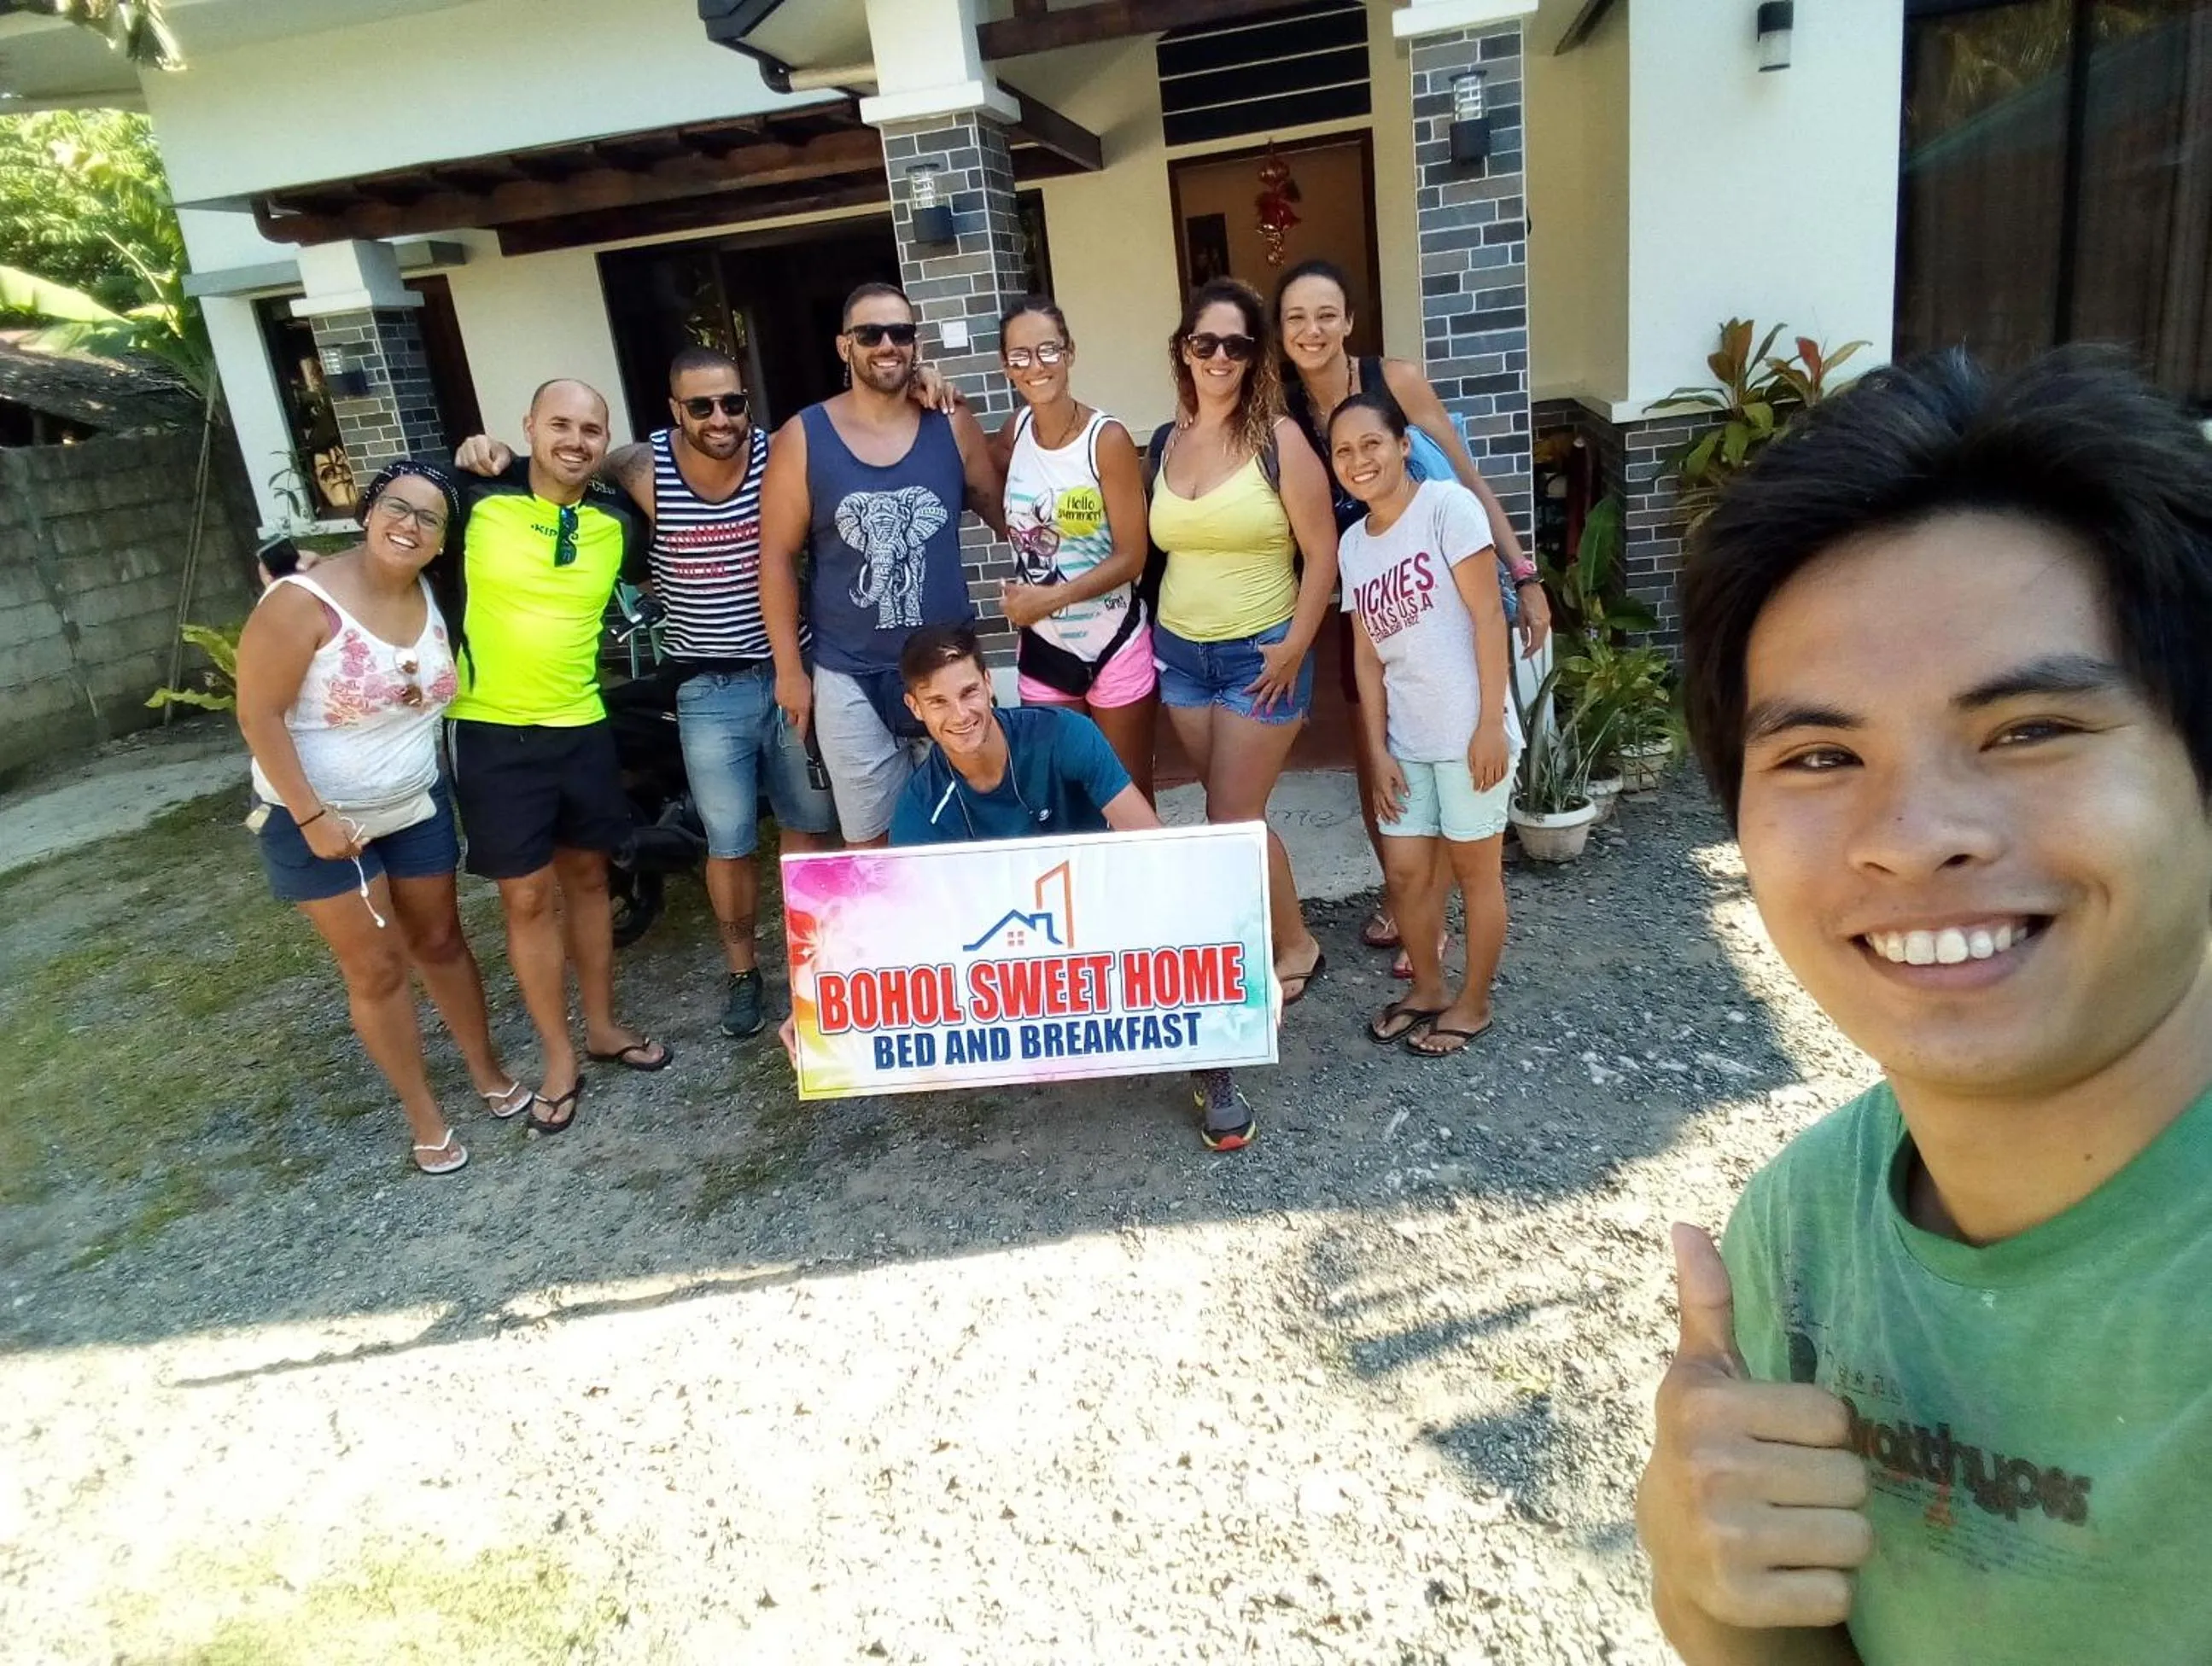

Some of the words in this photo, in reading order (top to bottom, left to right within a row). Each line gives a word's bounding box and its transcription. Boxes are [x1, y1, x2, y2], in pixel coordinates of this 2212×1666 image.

[1067, 496, 1094, 510] Hello
[817, 965, 963, 1033] BOHOL
[970, 953, 1112, 1022] SWEET
[1123, 943, 1245, 1009] HOME
[873, 1031, 937, 1070] BED
[944, 1026, 1011, 1065] AND
[1020, 1012, 1202, 1060] BREAKFAST
